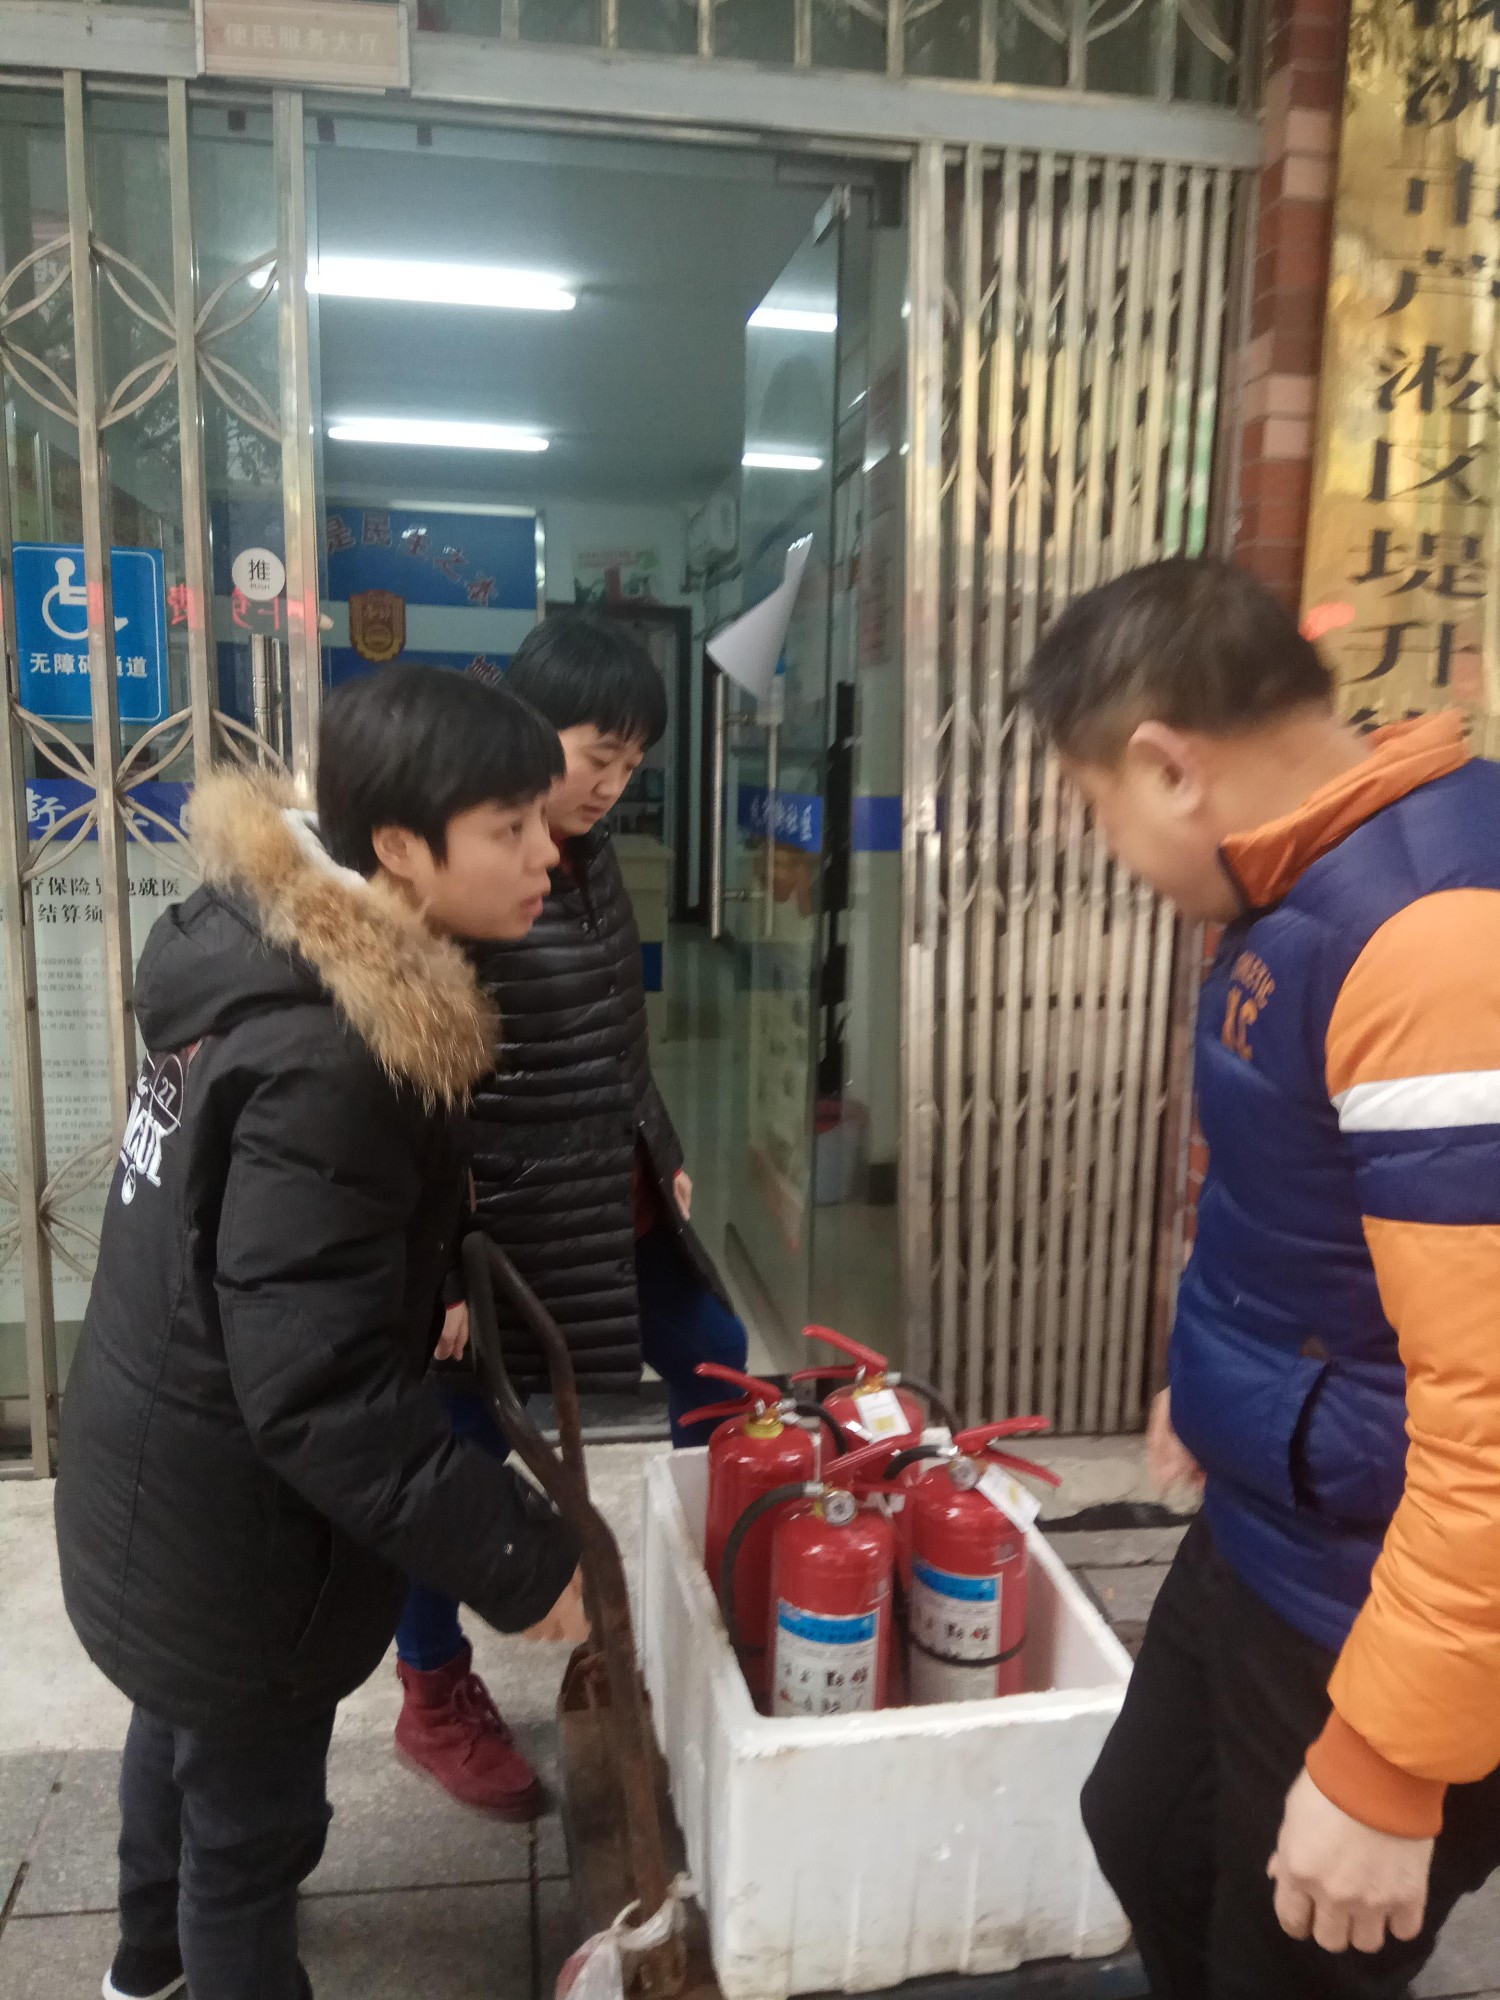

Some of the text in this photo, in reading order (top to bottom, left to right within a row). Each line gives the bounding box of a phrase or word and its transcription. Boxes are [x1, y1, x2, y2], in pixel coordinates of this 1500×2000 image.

[248, 558, 271, 582] 推
[29, 652, 148, 678] 无障碍道
